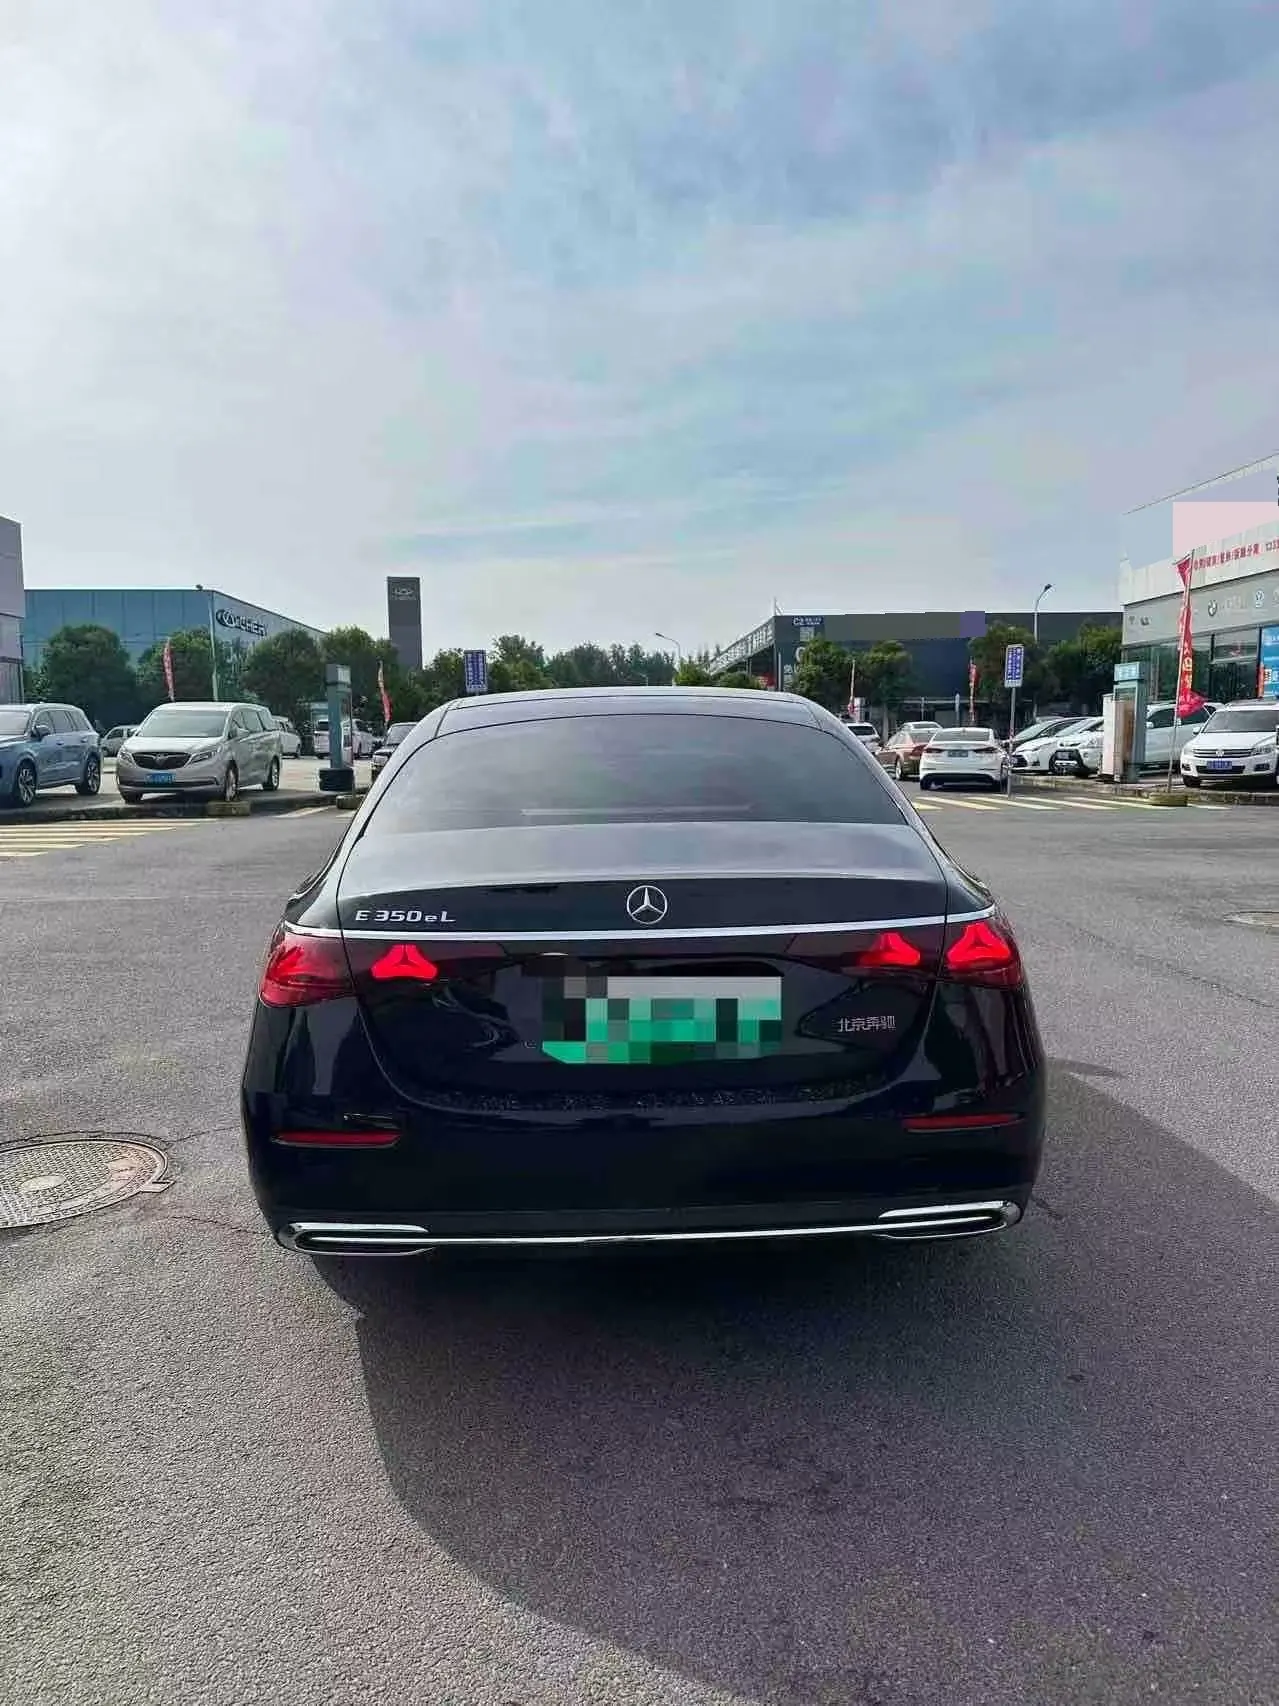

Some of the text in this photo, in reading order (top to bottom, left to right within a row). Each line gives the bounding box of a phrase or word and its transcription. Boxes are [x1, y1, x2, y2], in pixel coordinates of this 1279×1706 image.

[355, 910, 371, 921] E
[836, 1015, 896, 1033] 北京奔驰
